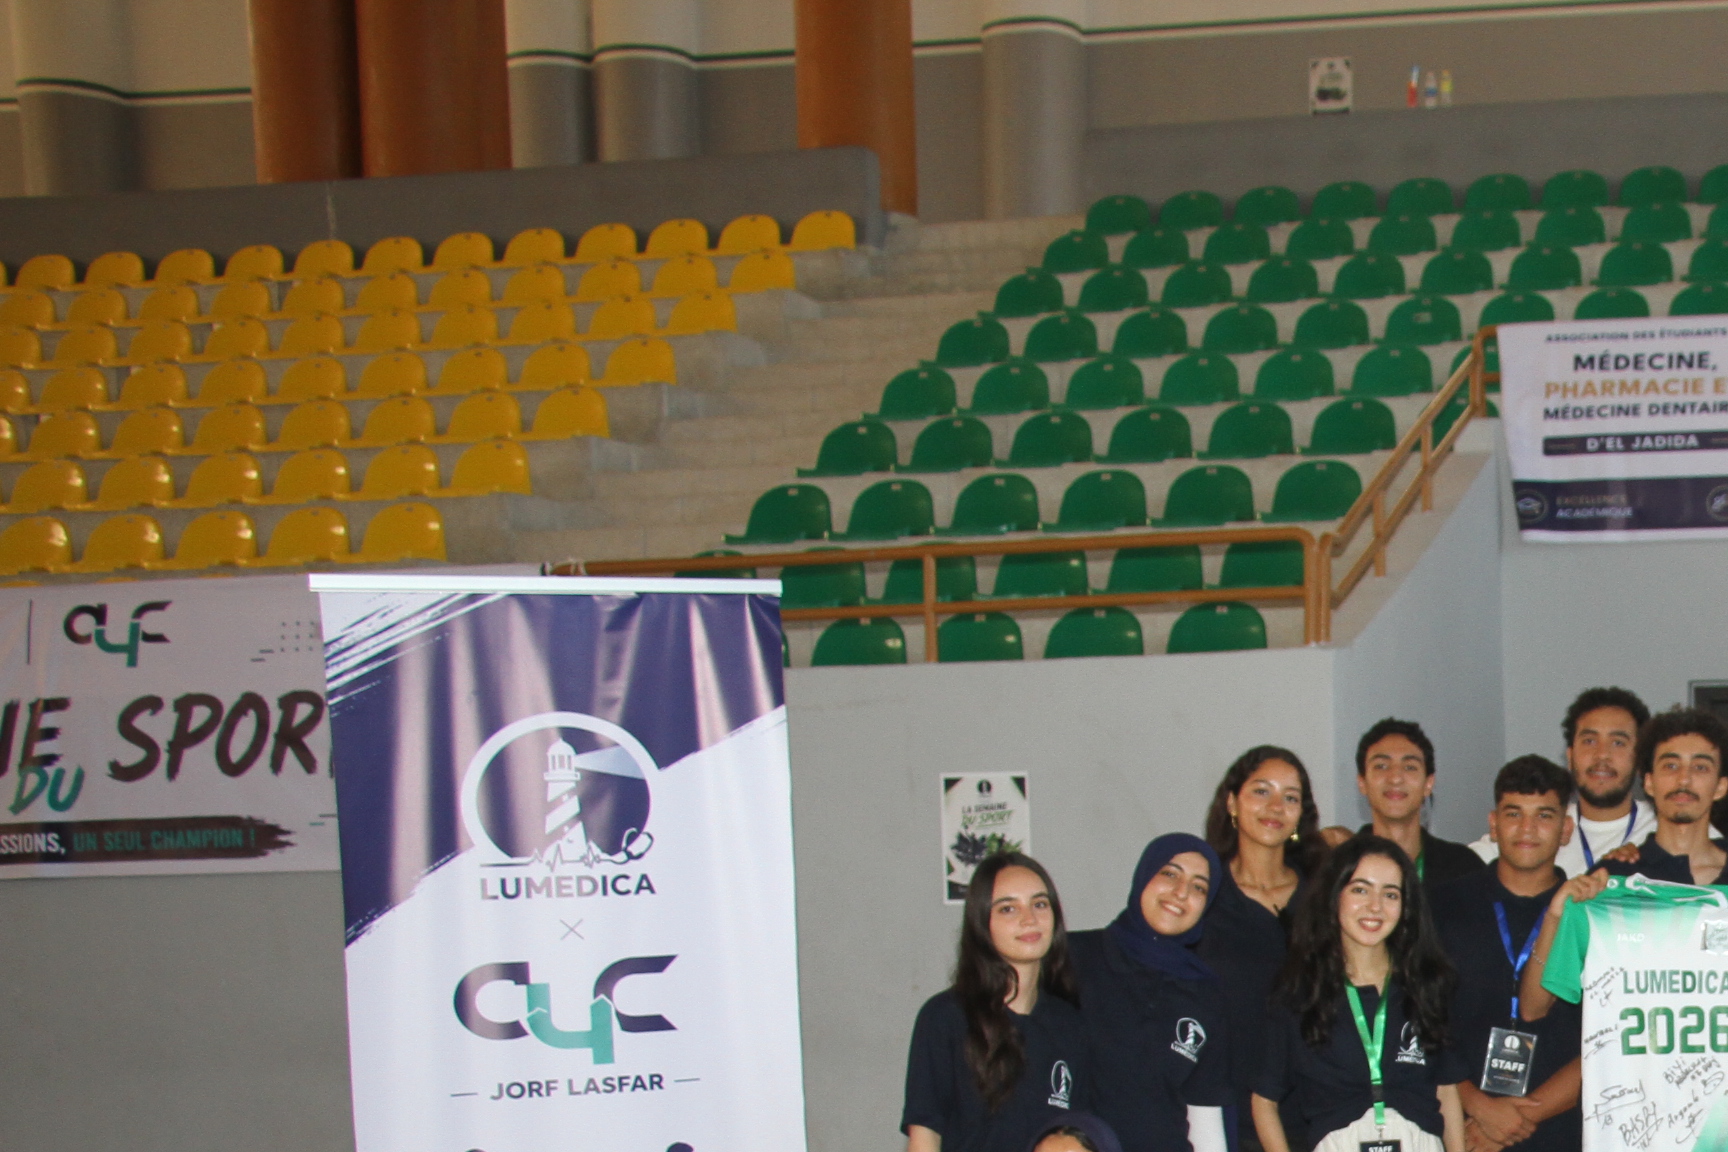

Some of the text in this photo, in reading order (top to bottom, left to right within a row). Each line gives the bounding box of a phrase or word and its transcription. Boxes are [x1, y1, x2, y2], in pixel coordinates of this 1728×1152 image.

[1546, 331, 1629, 342] ASSOCIATION
[1633, 330, 1655, 339] DES
[1573, 349, 1718, 371] MÉDECINE,
[1544, 377, 1705, 400] PHARMACIE
[1543, 402, 1641, 421] MÉDECINE
[1586, 434, 1699, 451] D'EL JADIDA
[108, 690, 334, 783] SPOR
[8, 765, 85, 815] DU
[73, 832, 97, 851] UN
[103, 831, 144, 850] SEUL
[151, 828, 243, 849] CHAMPION
[480, 872, 657, 901] LUMEDICA
[1491, 1058, 1526, 1073] STAFF
[490, 1073, 665, 1101] JORF LASFAR
